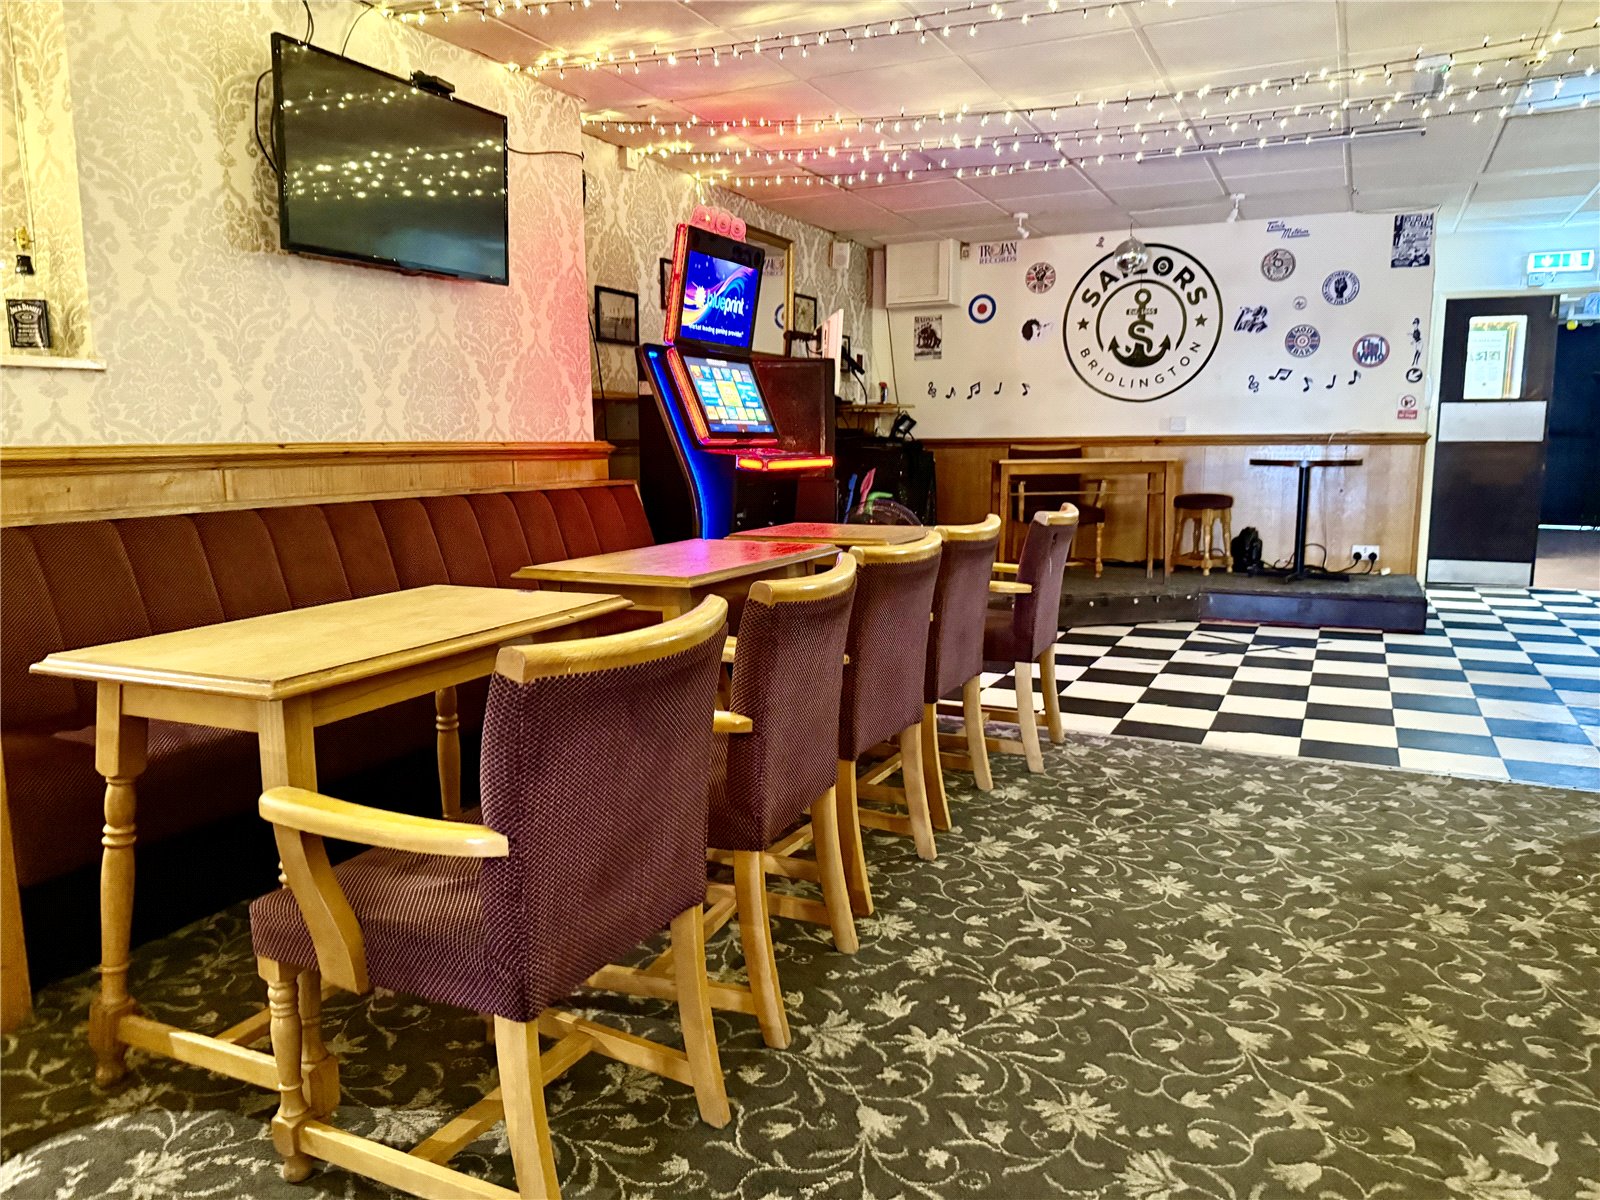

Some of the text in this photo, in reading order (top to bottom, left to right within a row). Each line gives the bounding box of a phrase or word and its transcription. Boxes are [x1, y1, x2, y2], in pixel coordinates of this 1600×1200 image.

[979, 255, 1017, 265] RECORDS
[980, 242, 1017, 257] TROJAN
[1081, 256, 1208, 308] SAORS
[707, 289, 745, 316] blueprint
[1293, 347, 1311, 356] BAR
[1080, 341, 1201, 389] BRIDLINGTON
